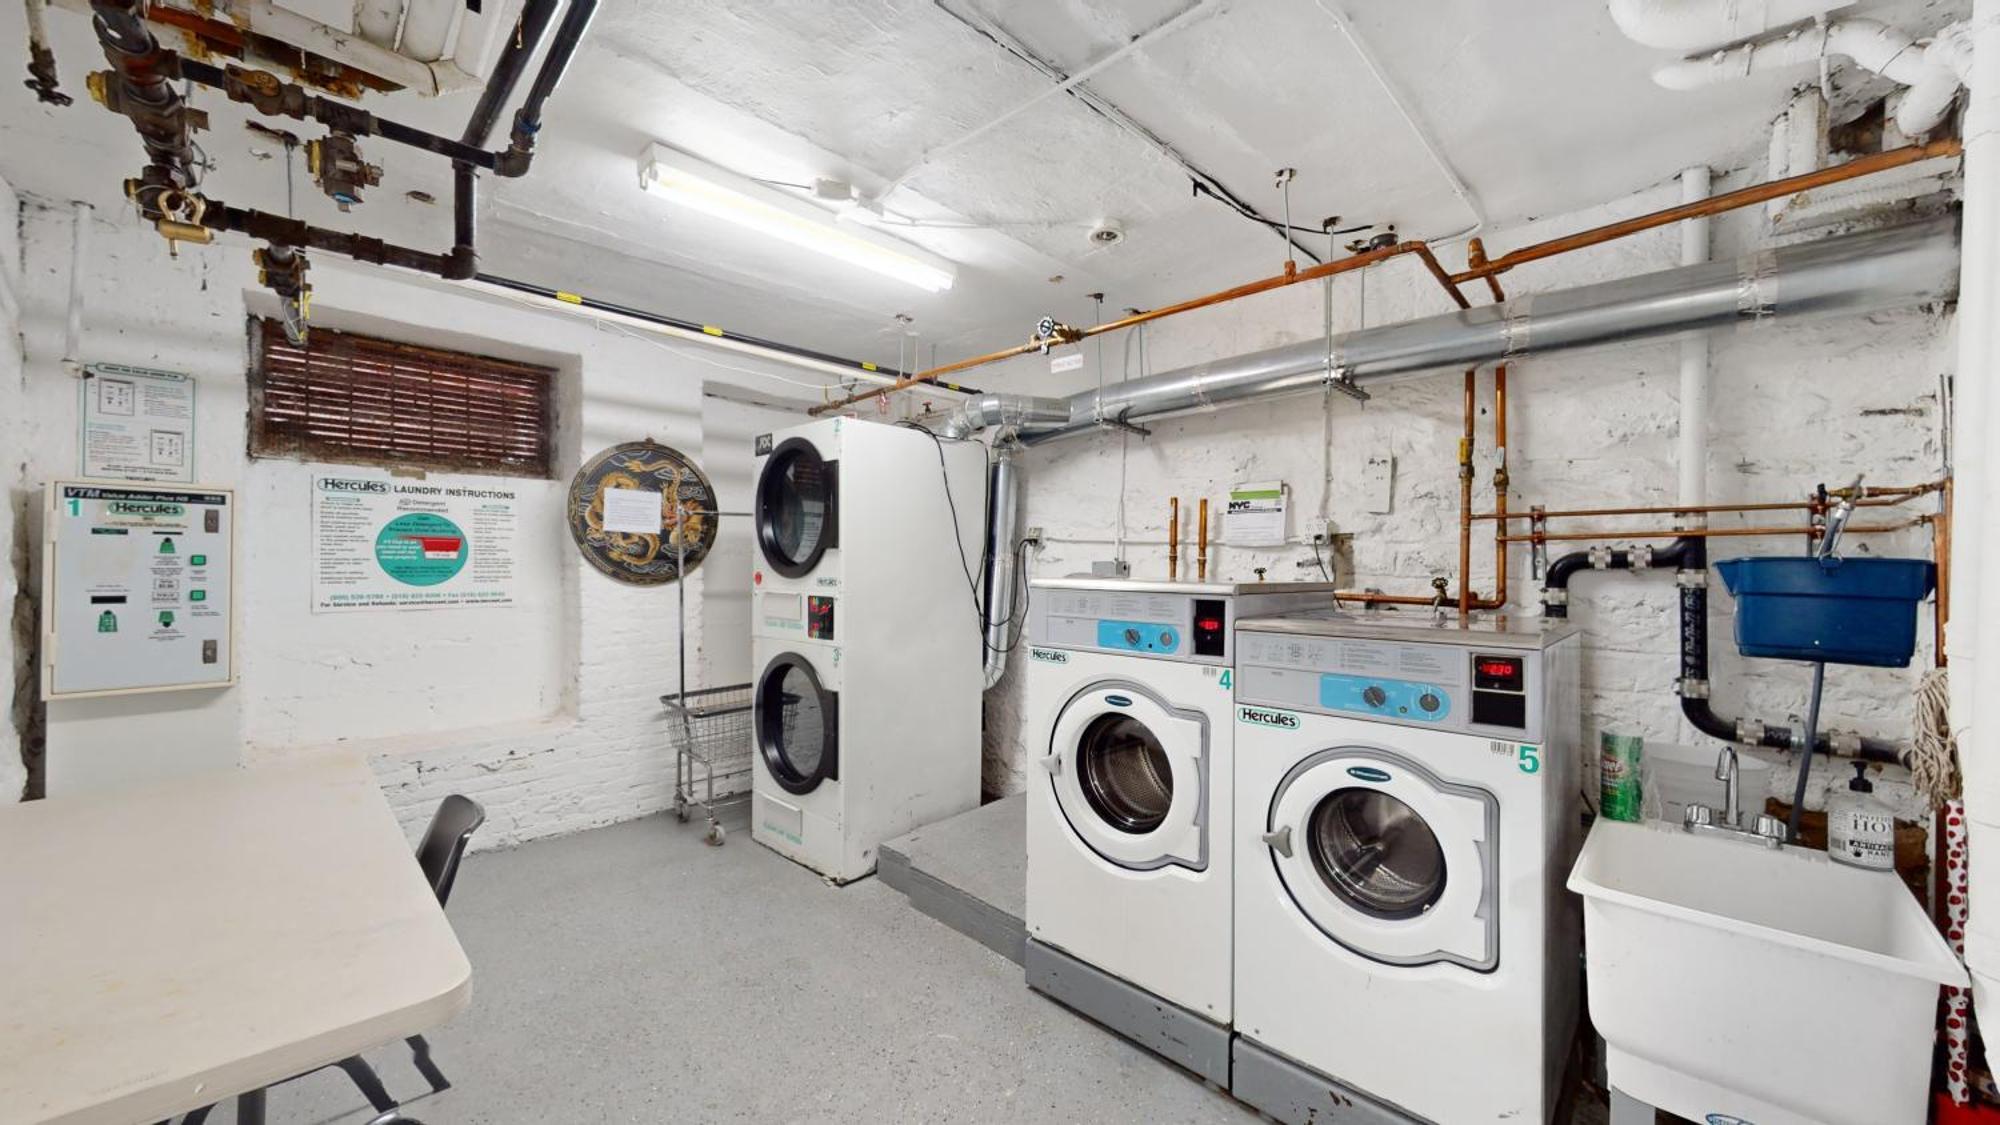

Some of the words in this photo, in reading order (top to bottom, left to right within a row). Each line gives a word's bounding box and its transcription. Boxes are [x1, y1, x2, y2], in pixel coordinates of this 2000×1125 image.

[67, 488, 100, 498] VTM
[324, 478, 387, 492] Hercules
[394, 485, 442, 496] LAUNDRY
[446, 488, 515, 500] INSTRUCTIONS
[67, 499, 80, 516] 1
[115, 501, 178, 514] Hercules
[1229, 500, 1250, 510] NYC
[1032, 649, 1067, 662] Hercules
[1218, 670, 1233, 690] 4
[1242, 708, 1297, 727] Hercules
[1518, 745, 1540, 774] 5
